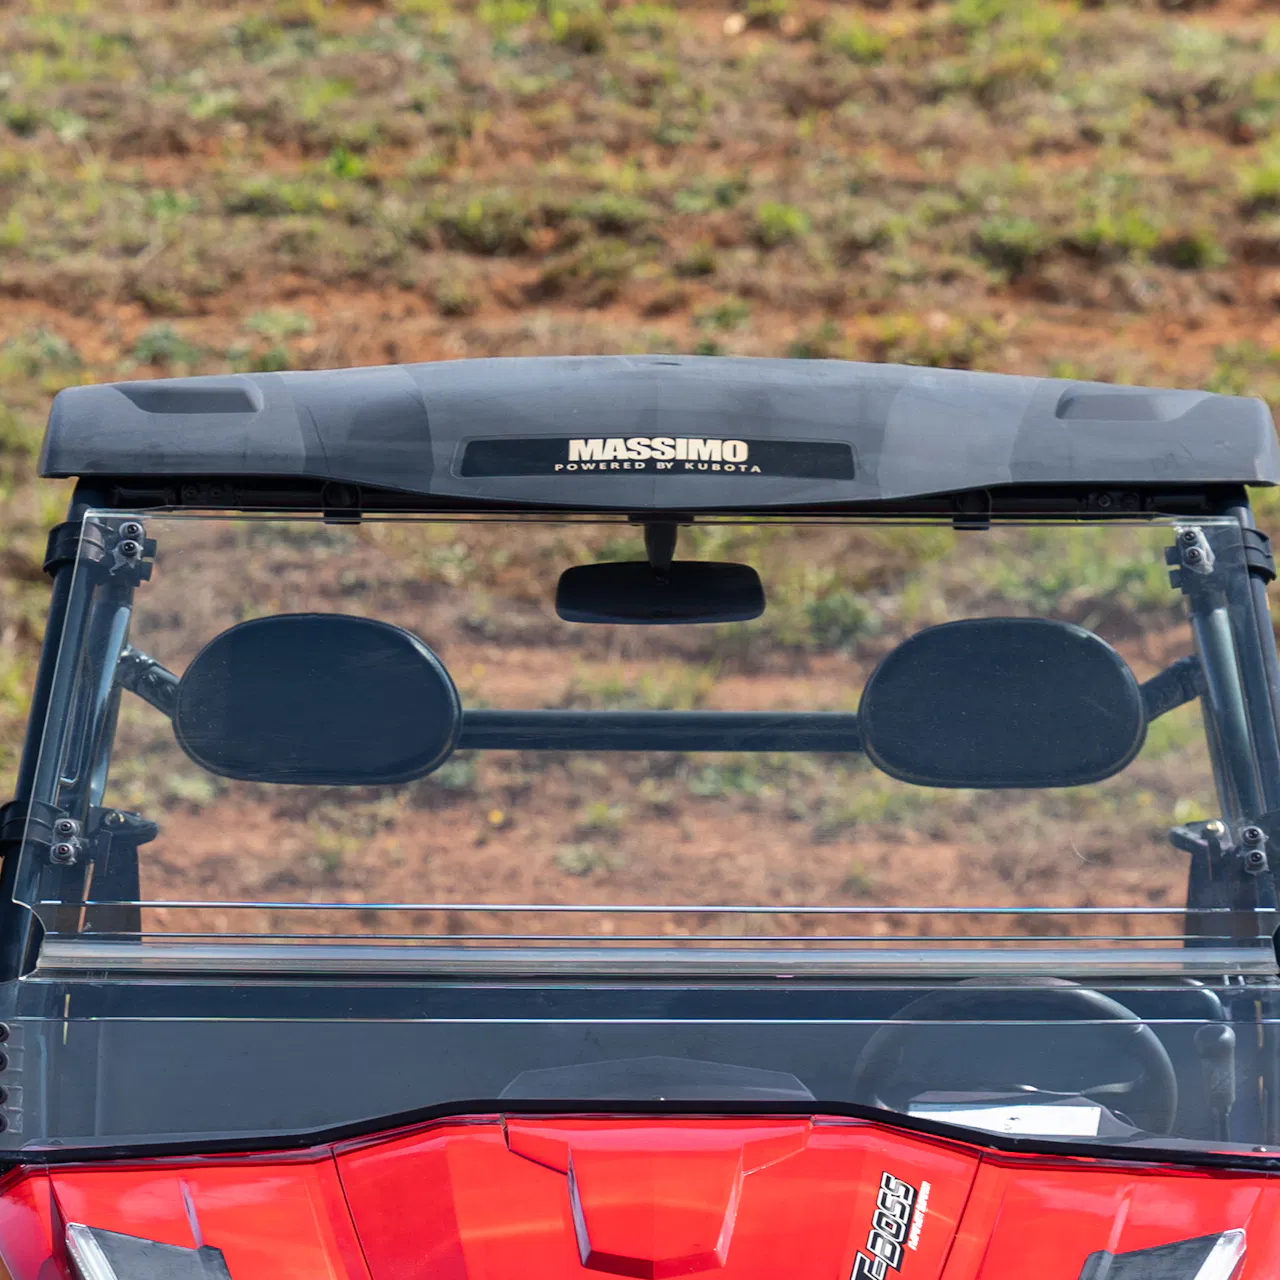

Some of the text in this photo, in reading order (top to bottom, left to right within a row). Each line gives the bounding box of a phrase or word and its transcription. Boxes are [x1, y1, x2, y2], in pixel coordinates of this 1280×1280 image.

[568, 437, 749, 463] MASSIMO
[554, 461, 762, 473] POWERED BY KUBOTA
